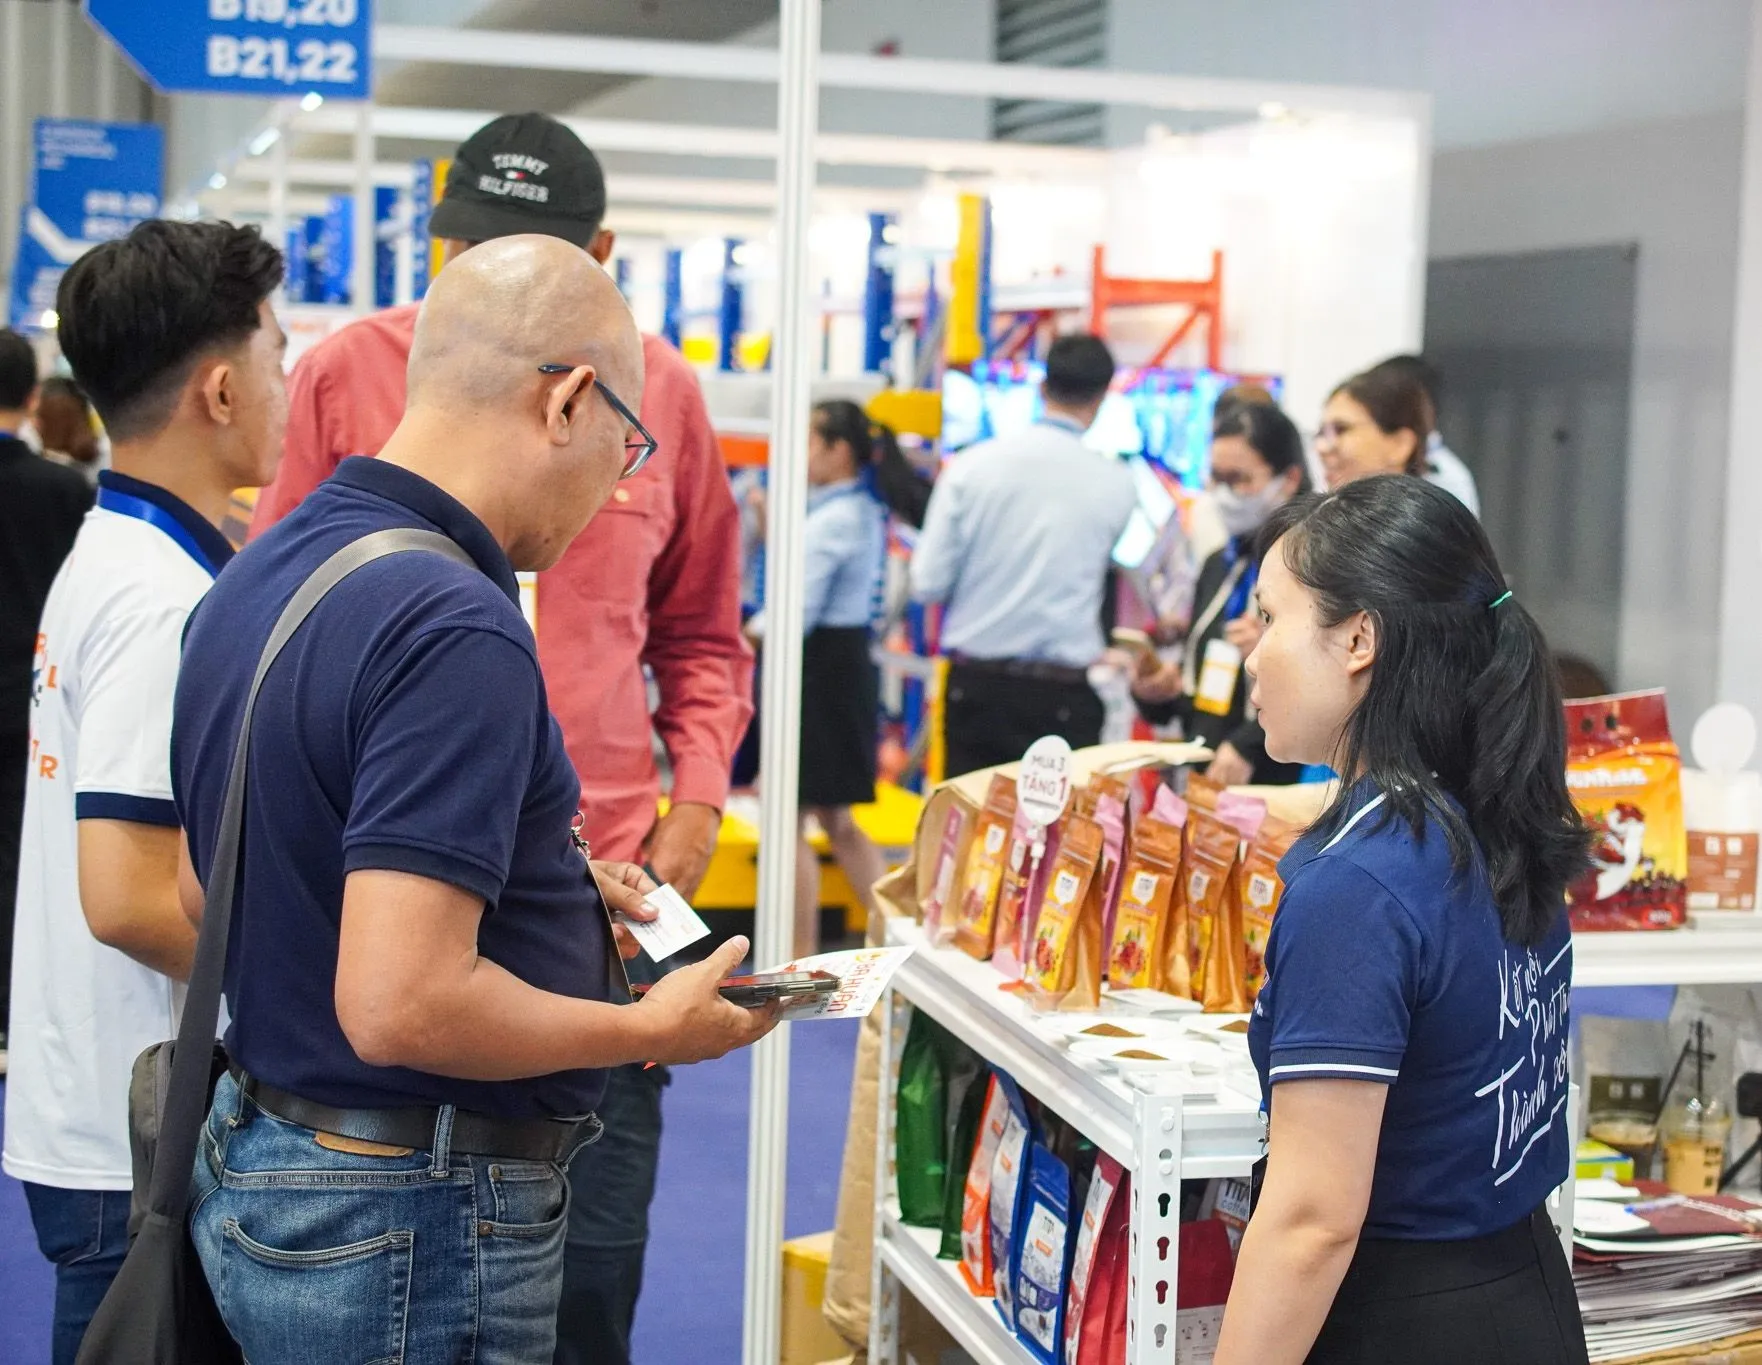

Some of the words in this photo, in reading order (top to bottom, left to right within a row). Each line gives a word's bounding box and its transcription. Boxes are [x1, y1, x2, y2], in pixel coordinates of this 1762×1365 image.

[207, 35, 358, 84] B21,22
[492, 154, 549, 176] TOMMY
[479, 174, 549, 202] HILFIGER
[1031, 755, 1055, 771] MUA
[1060, 775, 1068, 803] 1
[1475, 1055, 1547, 1168] Thành
